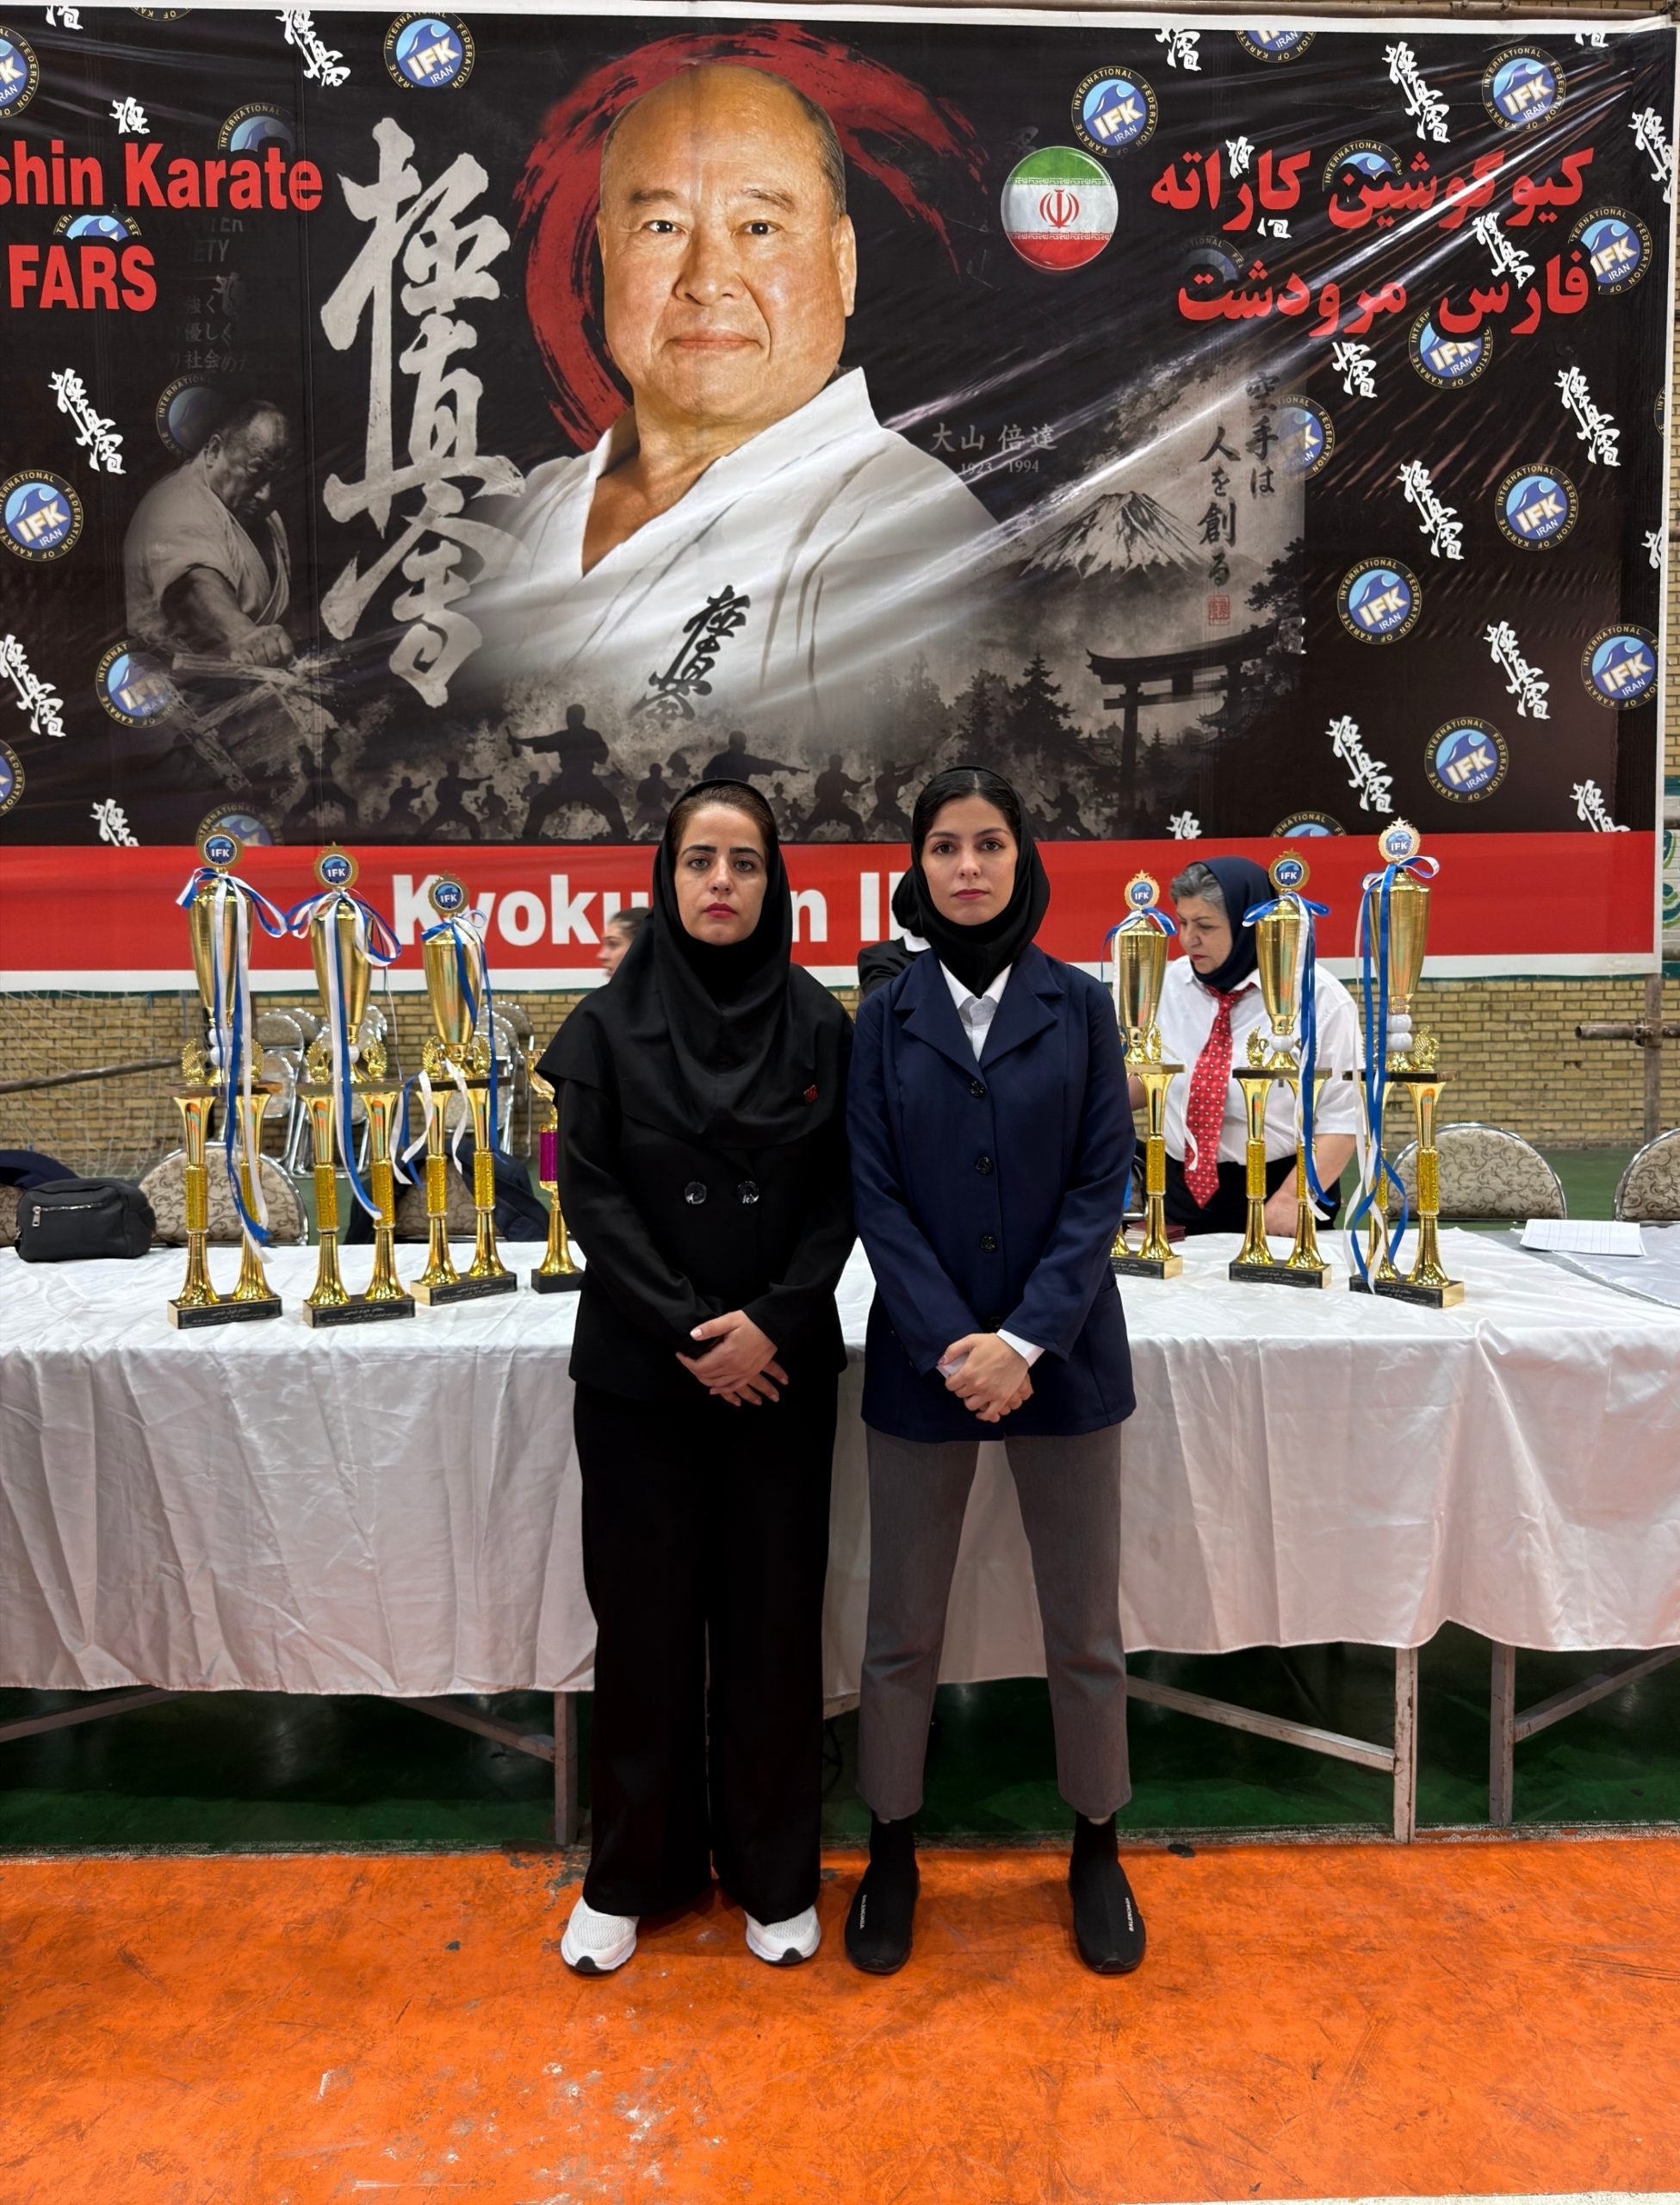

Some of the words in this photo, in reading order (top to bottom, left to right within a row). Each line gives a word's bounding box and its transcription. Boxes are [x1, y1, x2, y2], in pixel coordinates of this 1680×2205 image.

[406, 37, 460, 81] IFK
[452, 23, 473, 88] FEDERATION
[1276, 31, 1299, 48] IRAN
[17, 41, 37, 108] FEDERATION
[389, 64, 413, 88] RATE
[431, 65, 454, 84] IRAN
[1484, 47, 1541, 87] INTERNATIONAL
[0, 84, 18, 102] RAN
[1074, 68, 1132, 109] INTERNATIONAL
[1503, 73, 1553, 115] IFK
[1545, 61, 1564, 121] FEDERATION
[220, 105, 281, 147] INTERNATIONAL
[1093, 96, 1144, 139] IFK
[1486, 102, 1516, 129] KARATE
[1523, 102, 1547, 119] IRAN
[1076, 124, 1108, 153] KARATE
[1114, 125, 1138, 142] IRAN
[125, 143, 323, 211] Karate
[1324, 142, 1382, 183] INTERNATIONAL
[1150, 150, 1311, 231] کاراته
[1571, 208, 1627, 241] TERNATIONAL
[1628, 223, 1650, 284] FEDERATION
[1590, 236, 1637, 277] IFK
[9, 245, 157, 312] FARS
[1439, 250, 1590, 334] فارس
[1608, 263, 1631, 281] IRAN
[1178, 260, 1408, 338] مرودشت
[1413, 357, 1443, 385] KARATE
[1429, 342, 1479, 371] IFK
[1450, 357, 1472, 374] IRAN
[1471, 329, 1491, 378] DERATION
[930, 422, 985, 452] 大山
[998, 424, 1057, 451] 倍達
[1312, 411, 1332, 472] FEDERATION
[1008, 459, 1039, 473] 1994
[1497, 466, 1554, 506] INTERNATIONAL
[0, 472, 54, 513] ERNATIONAL
[61, 488, 81, 550] FEDERATION
[15, 500, 69, 543] IFK
[1516, 493, 1565, 533] IFK
[1535, 519, 1559, 537] IRAN
[1556, 480, 1577, 540] FEDERATION
[39, 528, 63, 547] IRAN
[1499, 519, 1529, 547] KARATE
[1538, 540, 1549, 549] OF
[1340, 559, 1397, 599] INTERNATIONAL
[1358, 586, 1407, 627] IFK
[1379, 613, 1402, 630] IRAN
[1399, 573, 1420, 634] FEDERATION
[1341, 612, 1373, 641] KARATE
[1380, 634, 1392, 643] OF
[1583, 626, 1640, 666] INTERNATIONAL
[97, 643, 128, 682] INTERNAT
[1602, 652, 1652, 693] IFK
[1585, 680, 1615, 706] KARATE
[1621, 679, 1646, 696] IRAN
[102, 696, 133, 724] KARATE
[1427, 719, 1484, 759] INTERNATIONAL
[5, 749, 22, 811] FEDERATION
[1446, 746, 1494, 786] IFK
[1466, 772, 1488, 789] IRAN
[1486, 733, 1506, 792] FEDERATION
[1429, 773, 1460, 799] KARATE
[211, 848, 230, 858] IFK
[1391, 842, 1407, 851] IFK
[327, 868, 345, 878] IFK
[1280, 872, 1298, 880] IFK
[440, 894, 457, 903] IFK
